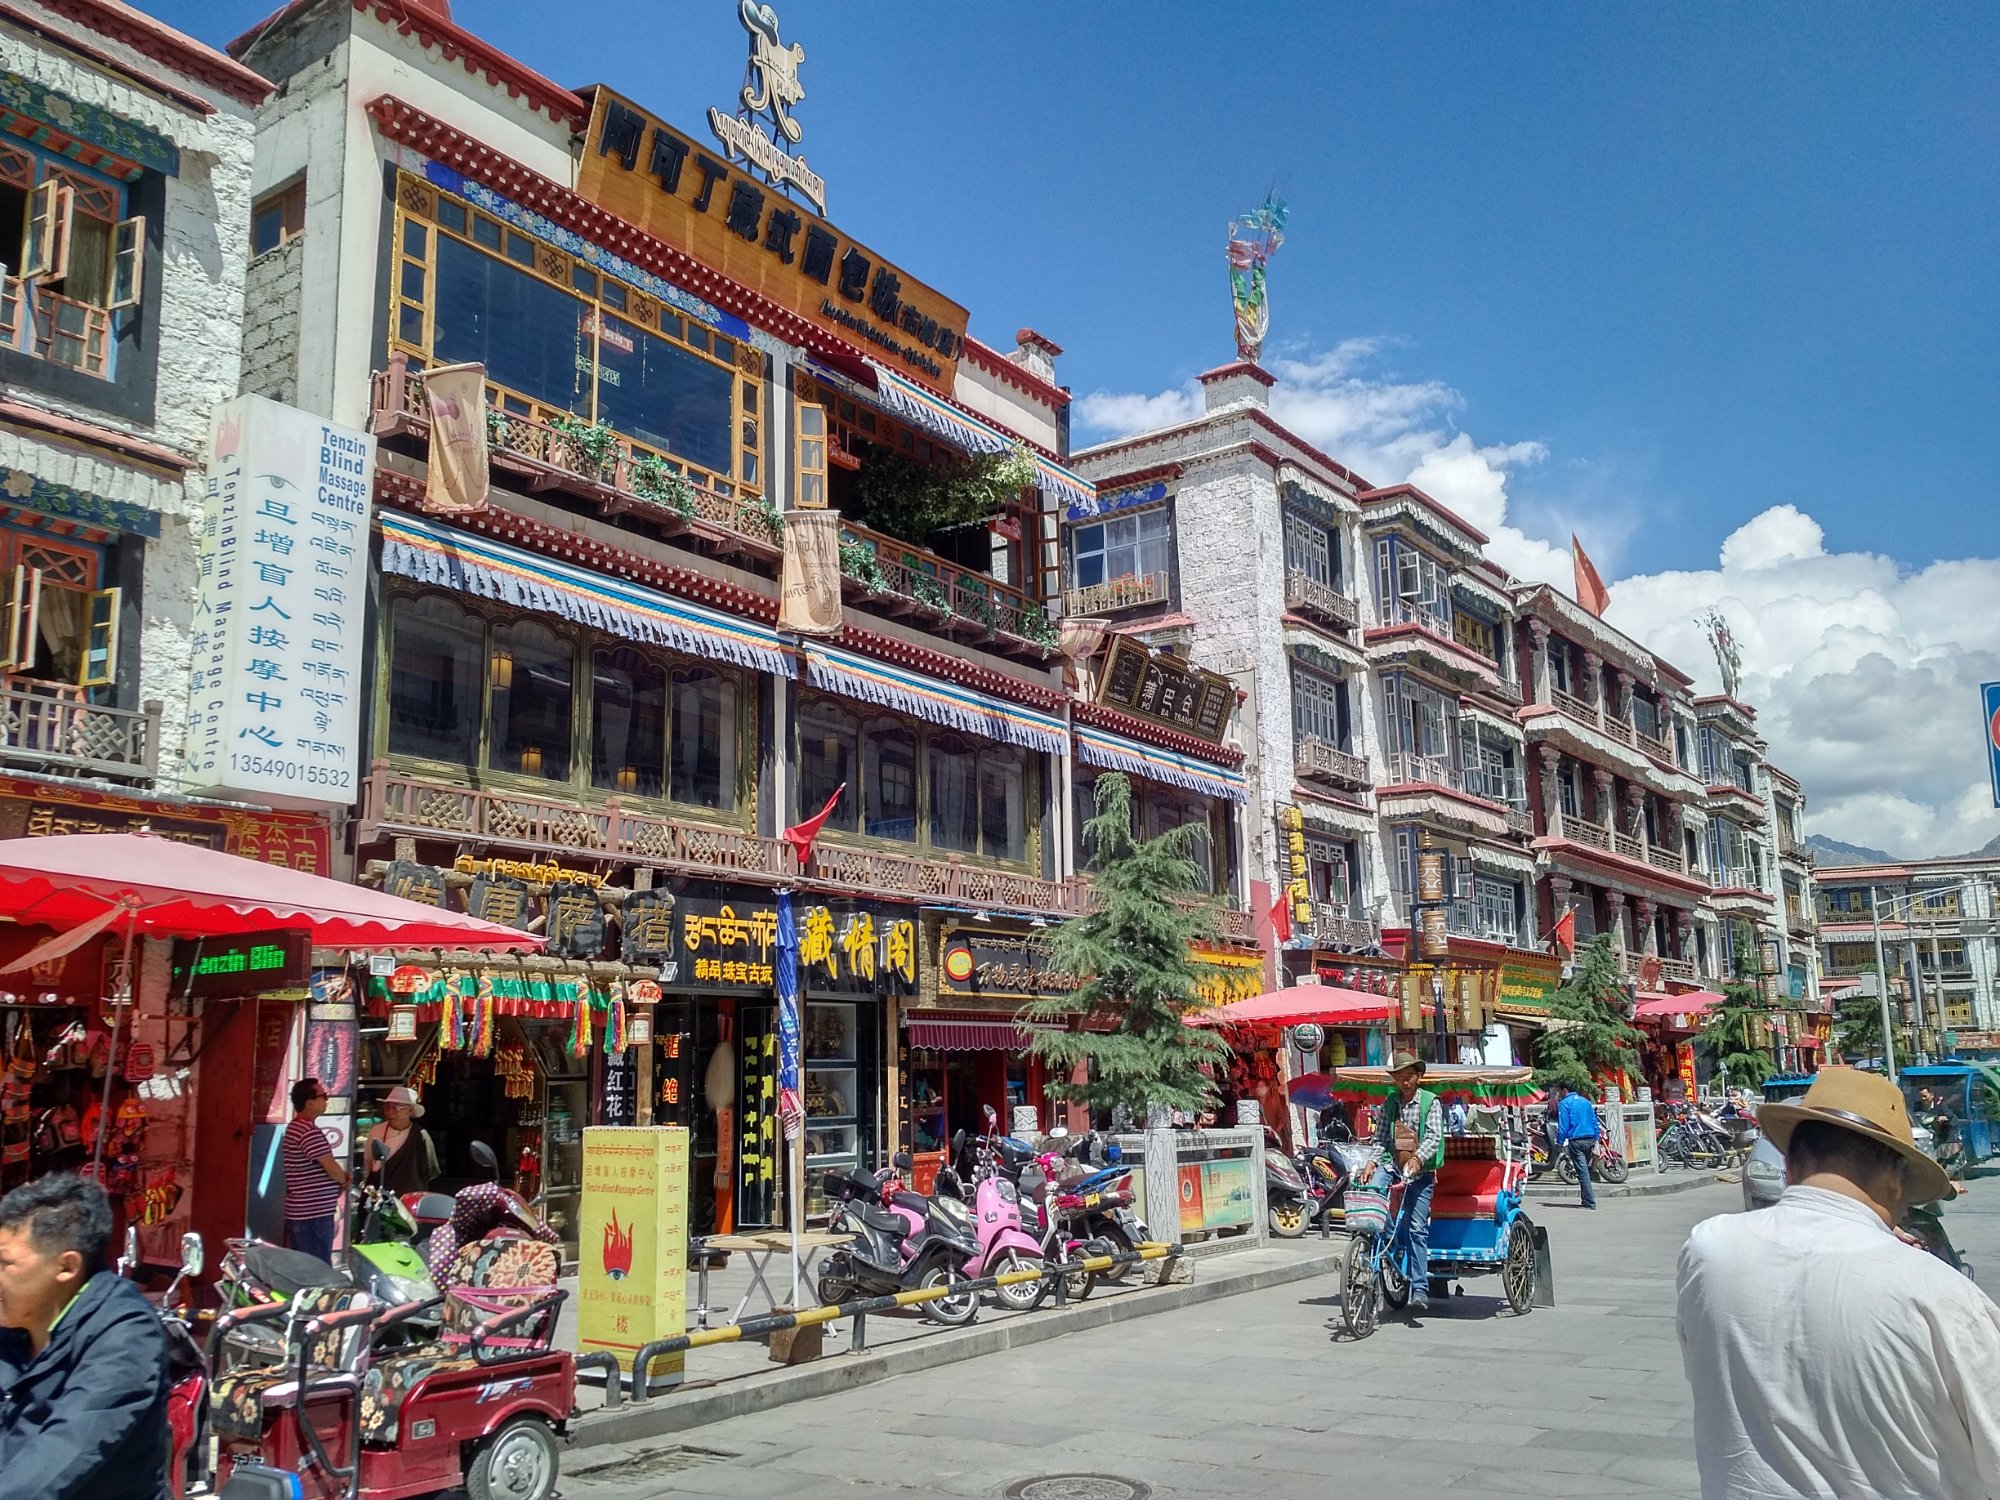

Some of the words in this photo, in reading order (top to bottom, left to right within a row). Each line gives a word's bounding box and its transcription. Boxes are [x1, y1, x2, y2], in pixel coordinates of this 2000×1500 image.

[321, 425, 367, 457] Tenzin
[320, 446, 364, 476] Blind
[318, 466, 366, 497] Massage
[220, 466, 241, 535] Tenzin
[317, 486, 365, 516] Centre
[217, 536, 237, 591] Blind
[239, 499, 298, 748] 旦增盲人按摩中心
[206, 600, 232, 690] Massage
[1141, 701, 1151, 711] PO
[1160, 708, 1169, 717] BA
[203, 699, 224, 770] Centre
[230, 753, 350, 788] 13549015532
